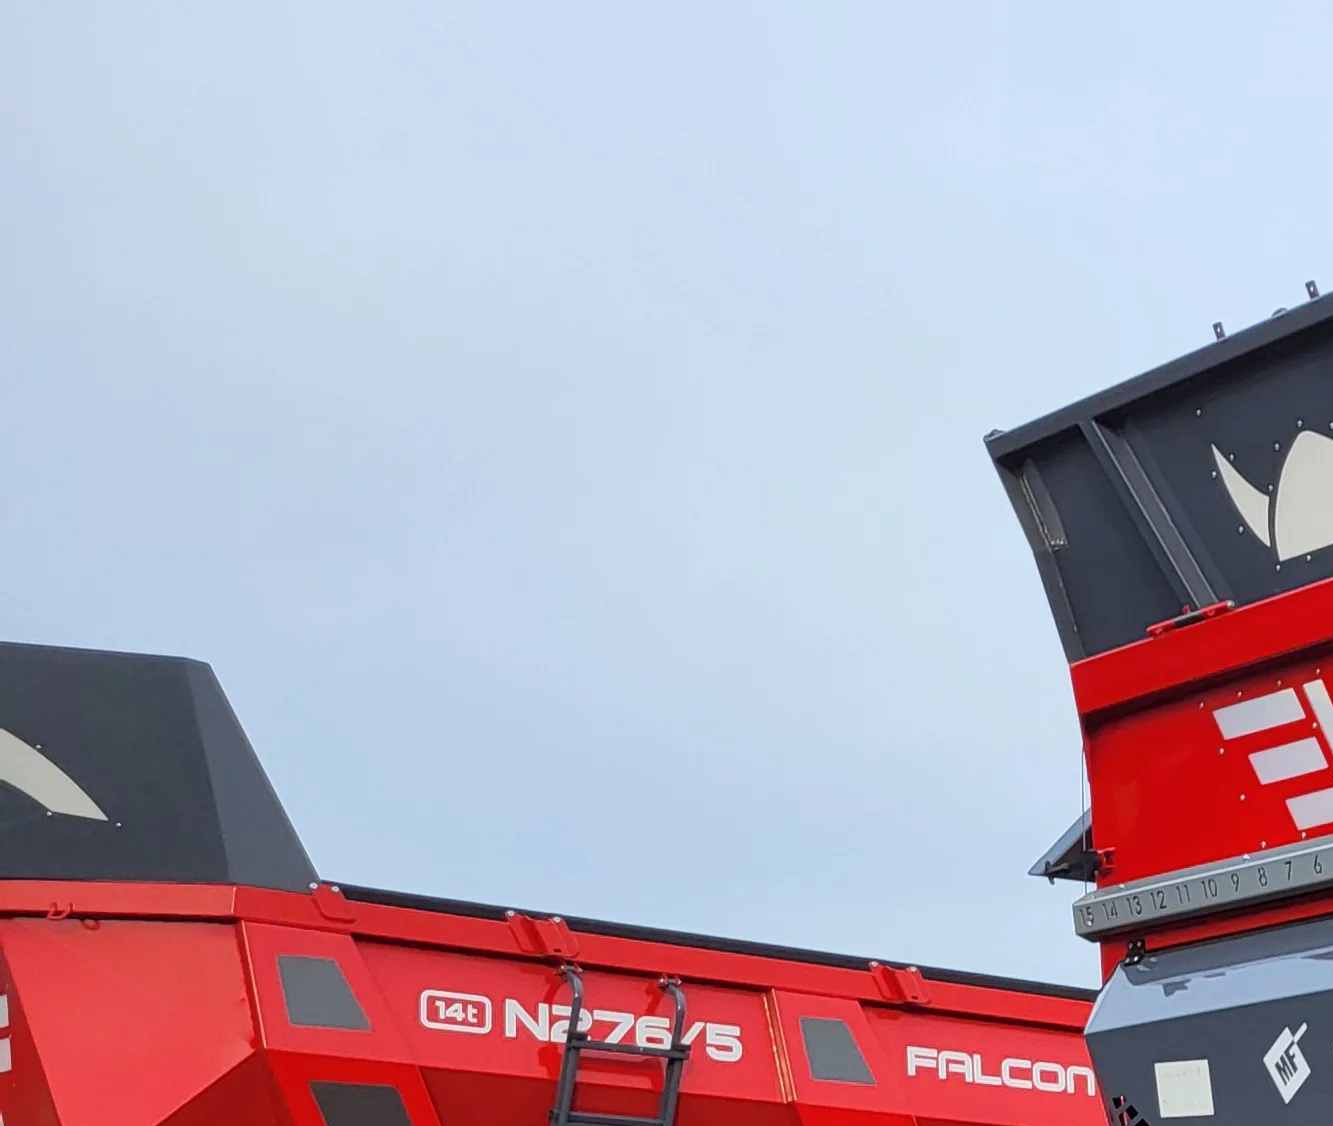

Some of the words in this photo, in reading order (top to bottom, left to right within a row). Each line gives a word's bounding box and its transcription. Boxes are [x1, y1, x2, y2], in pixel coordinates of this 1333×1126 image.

[1079, 908, 1094, 927] 15
[1102, 901, 1119, 920] 14
[1126, 895, 1143, 916] 13
[1150, 890, 1167, 911] 12
[1175, 884, 1191, 905] 11
[1201, 878, 1218, 899] 10
[1230, 873, 1240, 893] 9
[1257, 867, 1268, 887] 8
[1284, 861, 1293, 881] 7
[1313, 854, 1323, 875] 6
[435, 1000, 478, 1023] 14t
[504, 998, 743, 1063] N276/5
[906, 1045, 1096, 1097] FALCON
